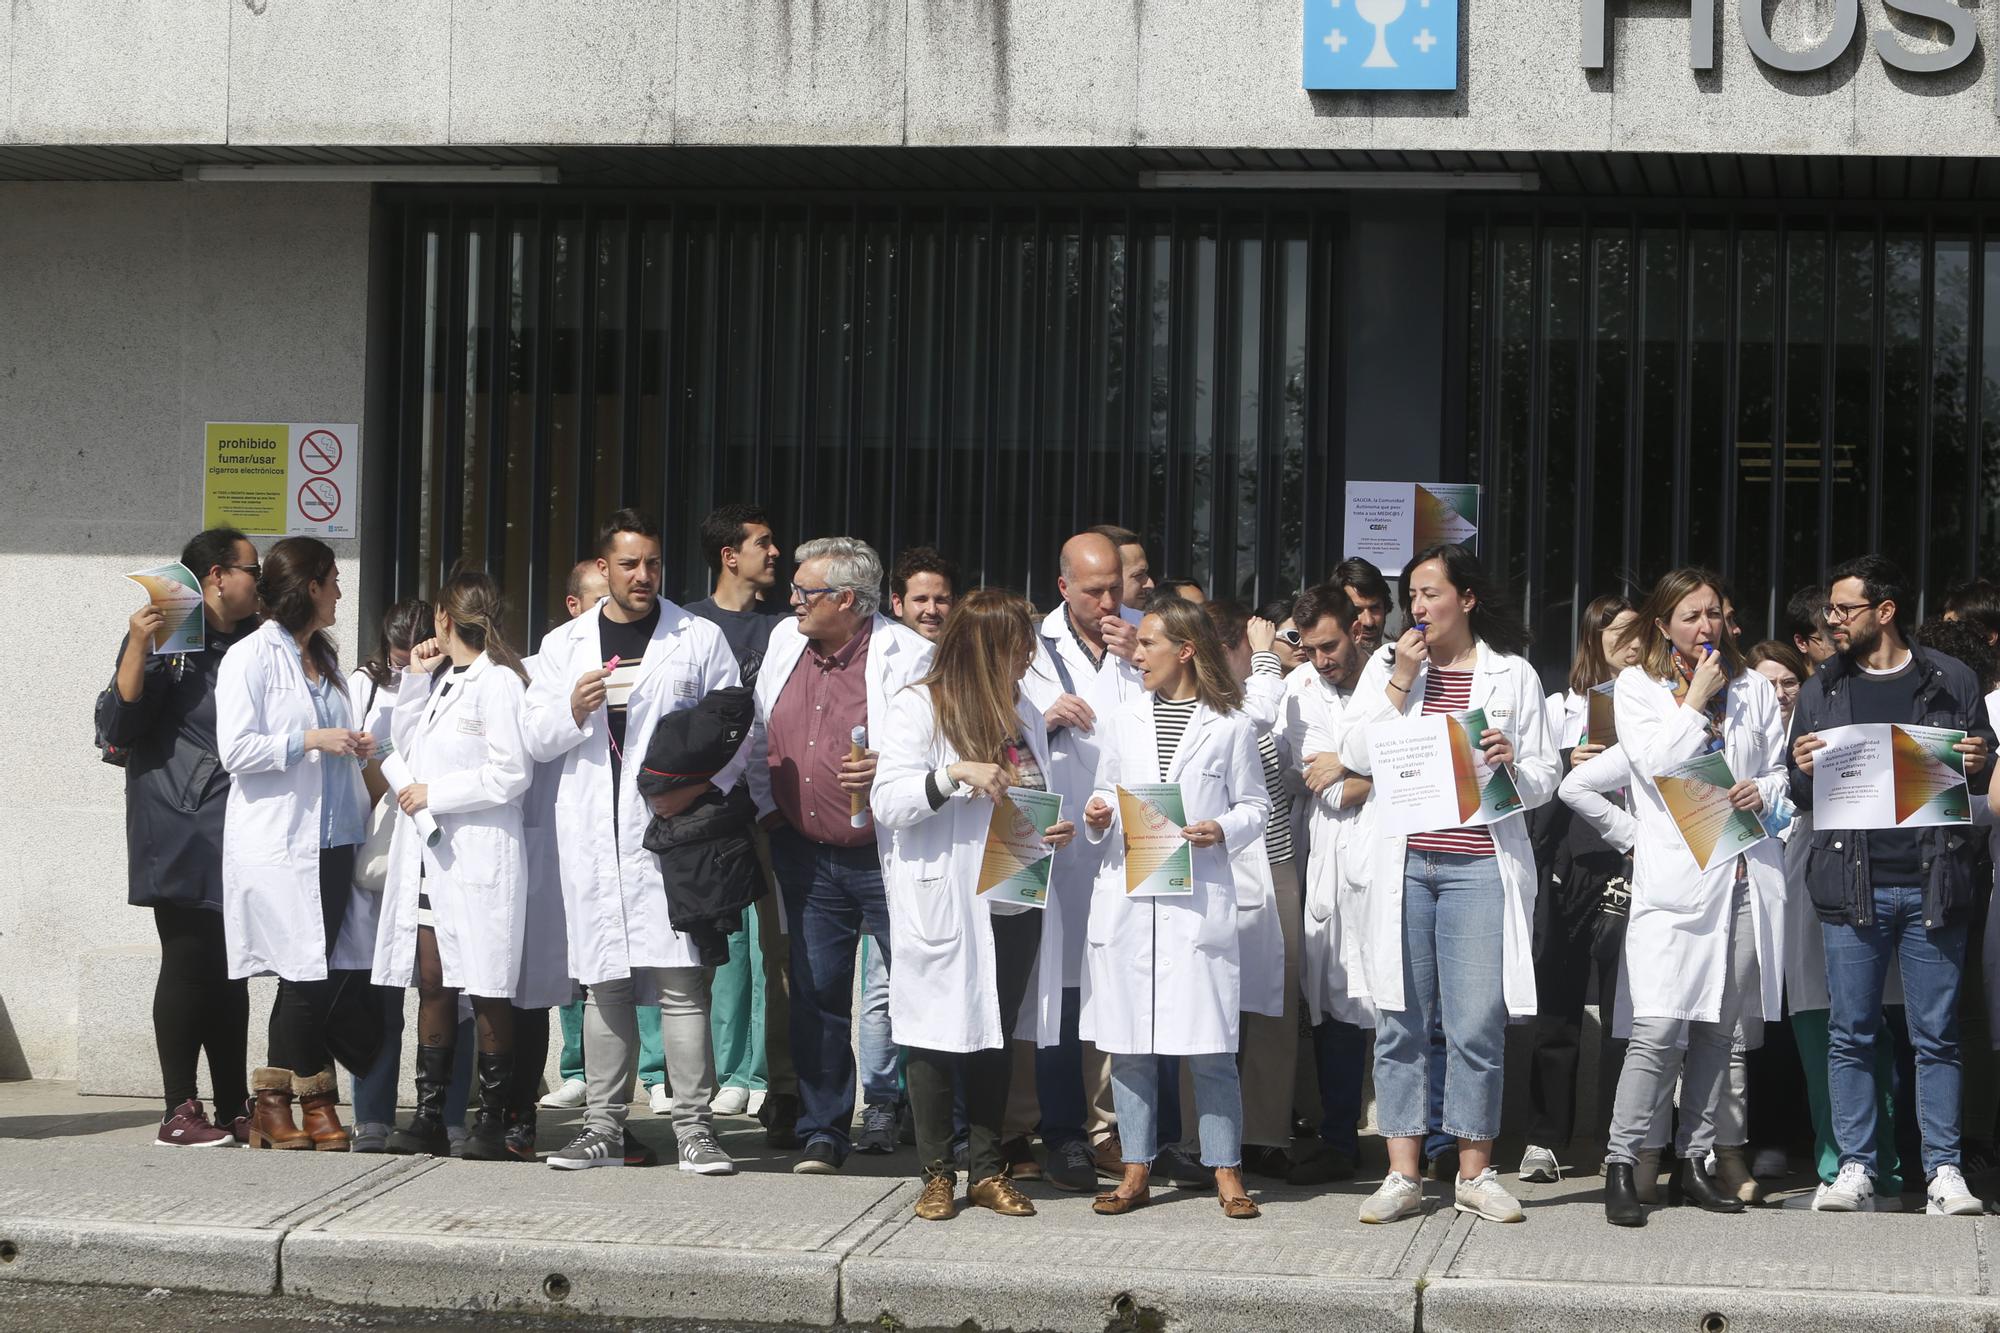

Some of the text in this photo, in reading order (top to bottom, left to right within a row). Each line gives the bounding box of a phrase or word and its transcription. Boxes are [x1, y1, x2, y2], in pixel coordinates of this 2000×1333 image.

[218, 438, 277, 451] prohibido
[218, 454, 277, 465] fumar/usar
[209, 466, 239, 475] cigarros
